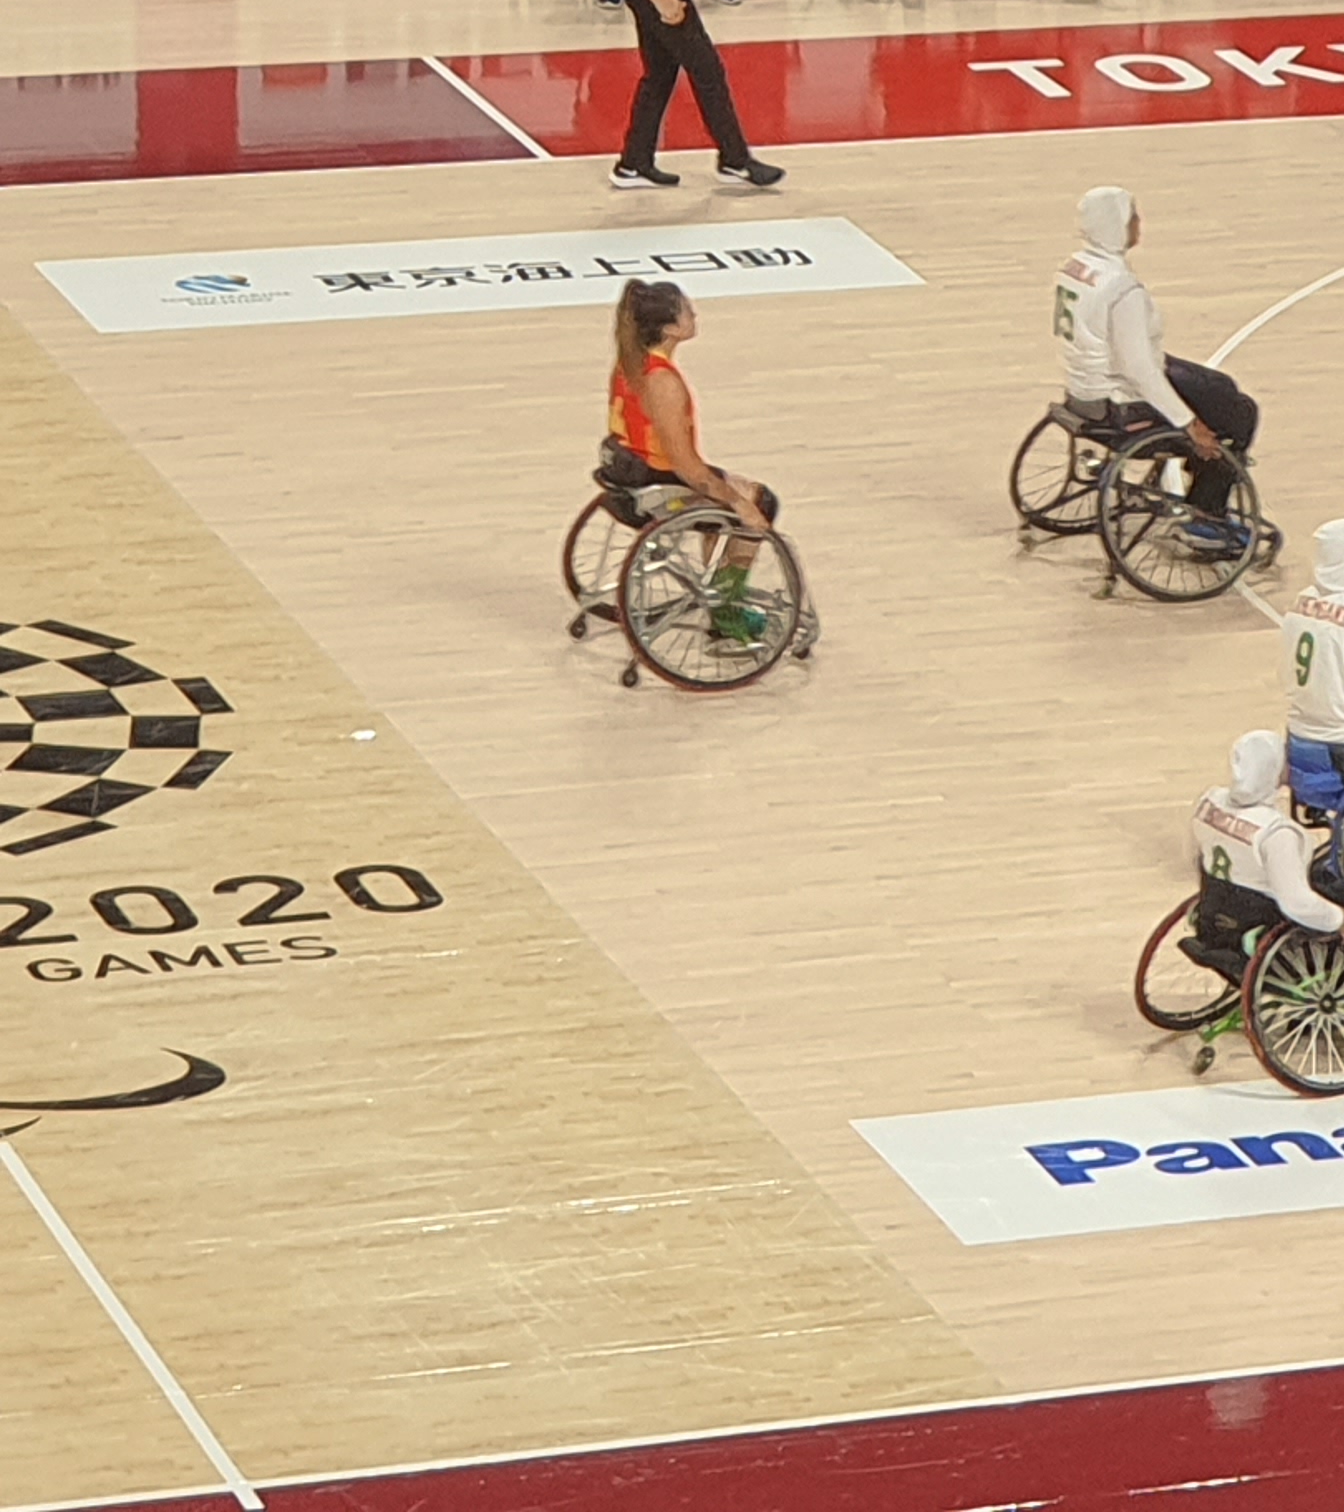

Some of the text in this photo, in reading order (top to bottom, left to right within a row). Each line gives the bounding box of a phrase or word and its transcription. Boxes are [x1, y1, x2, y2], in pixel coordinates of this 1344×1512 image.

[311, 247, 814, 294] 東京海上日動
[1295, 630, 1315, 688] 9
[0, 864, 444, 948] 2020
[26, 936, 338, 982] GAMES
